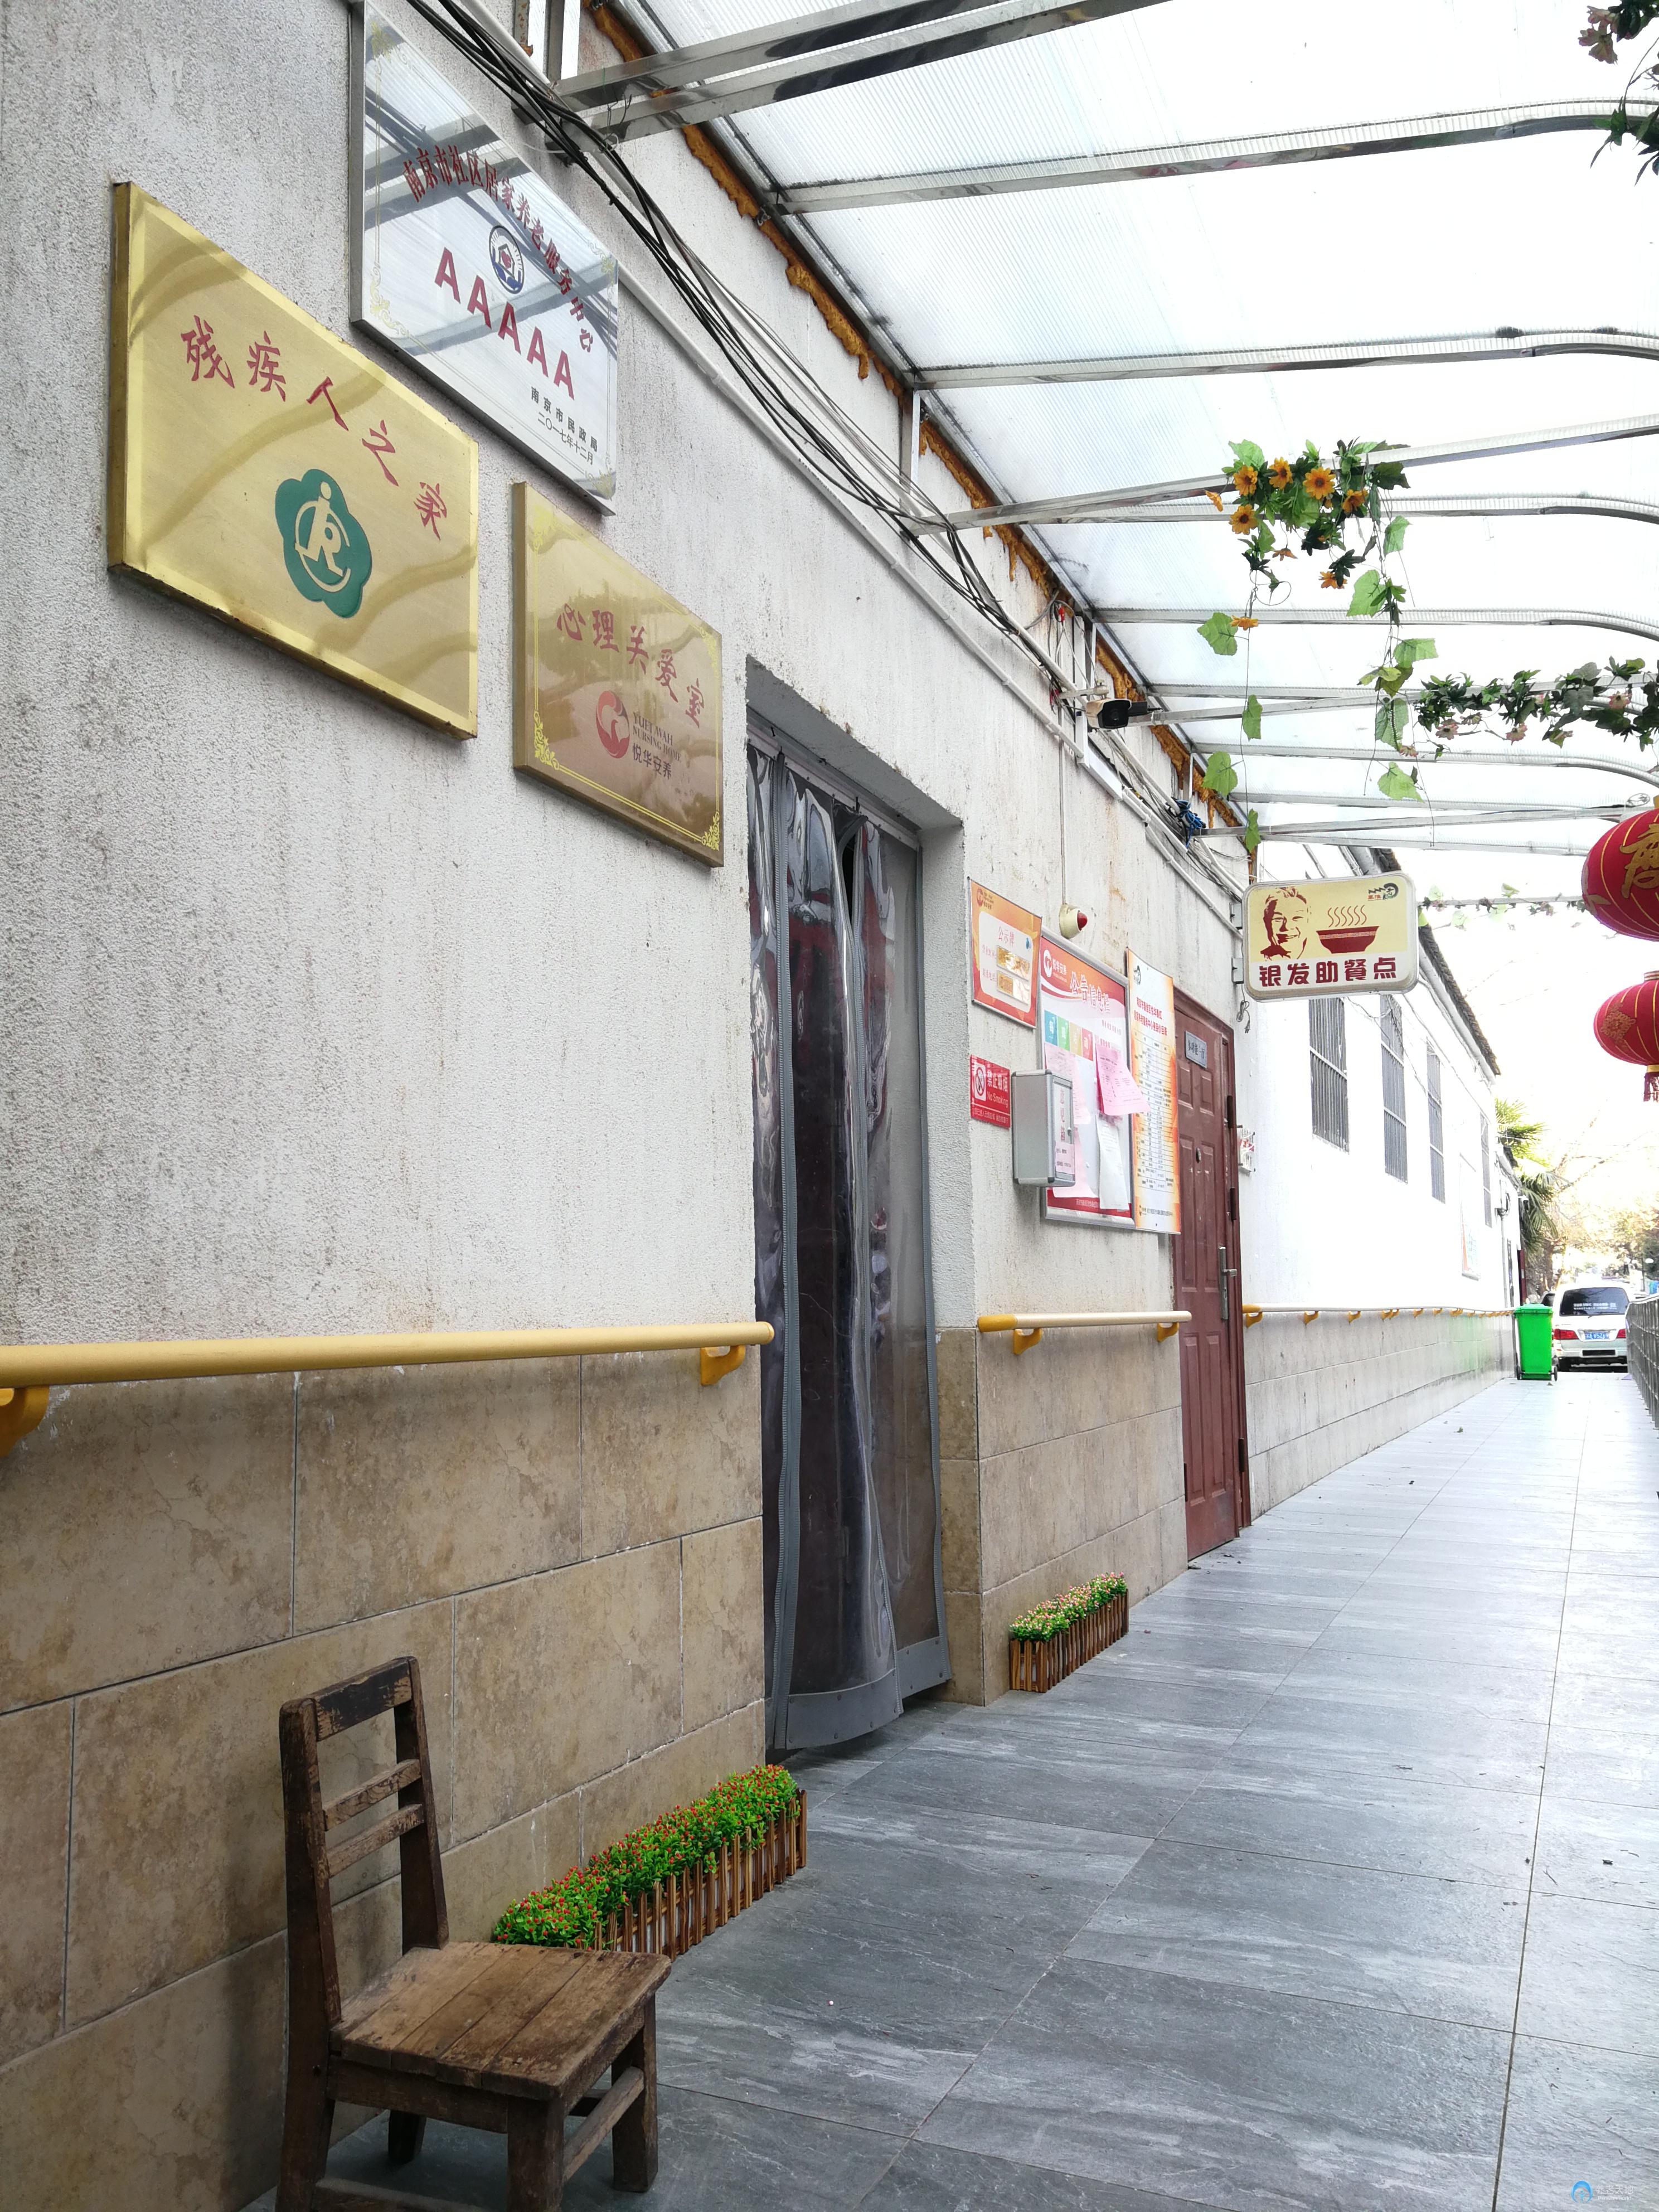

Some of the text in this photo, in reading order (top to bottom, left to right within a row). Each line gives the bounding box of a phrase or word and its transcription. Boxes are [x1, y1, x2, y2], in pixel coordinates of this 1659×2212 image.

[402, 144, 594, 353] 南京市社区居家养老服务中心
[180, 314, 447, 540] 残疾人之家
[531, 386, 598, 453] 南京市民政局
[557, 603, 705, 729] 心理关爱室
[633, 711, 673, 746] YUET WAH
[633, 725, 682, 763] NURSING HOME
[633, 742, 672, 780] 悦华安养
[1259, 957, 1396, 987] 银发助餐点
[987, 1070, 1008, 1093] 禁止吸烟
[987, 1091, 1008, 1108] No Smoking
